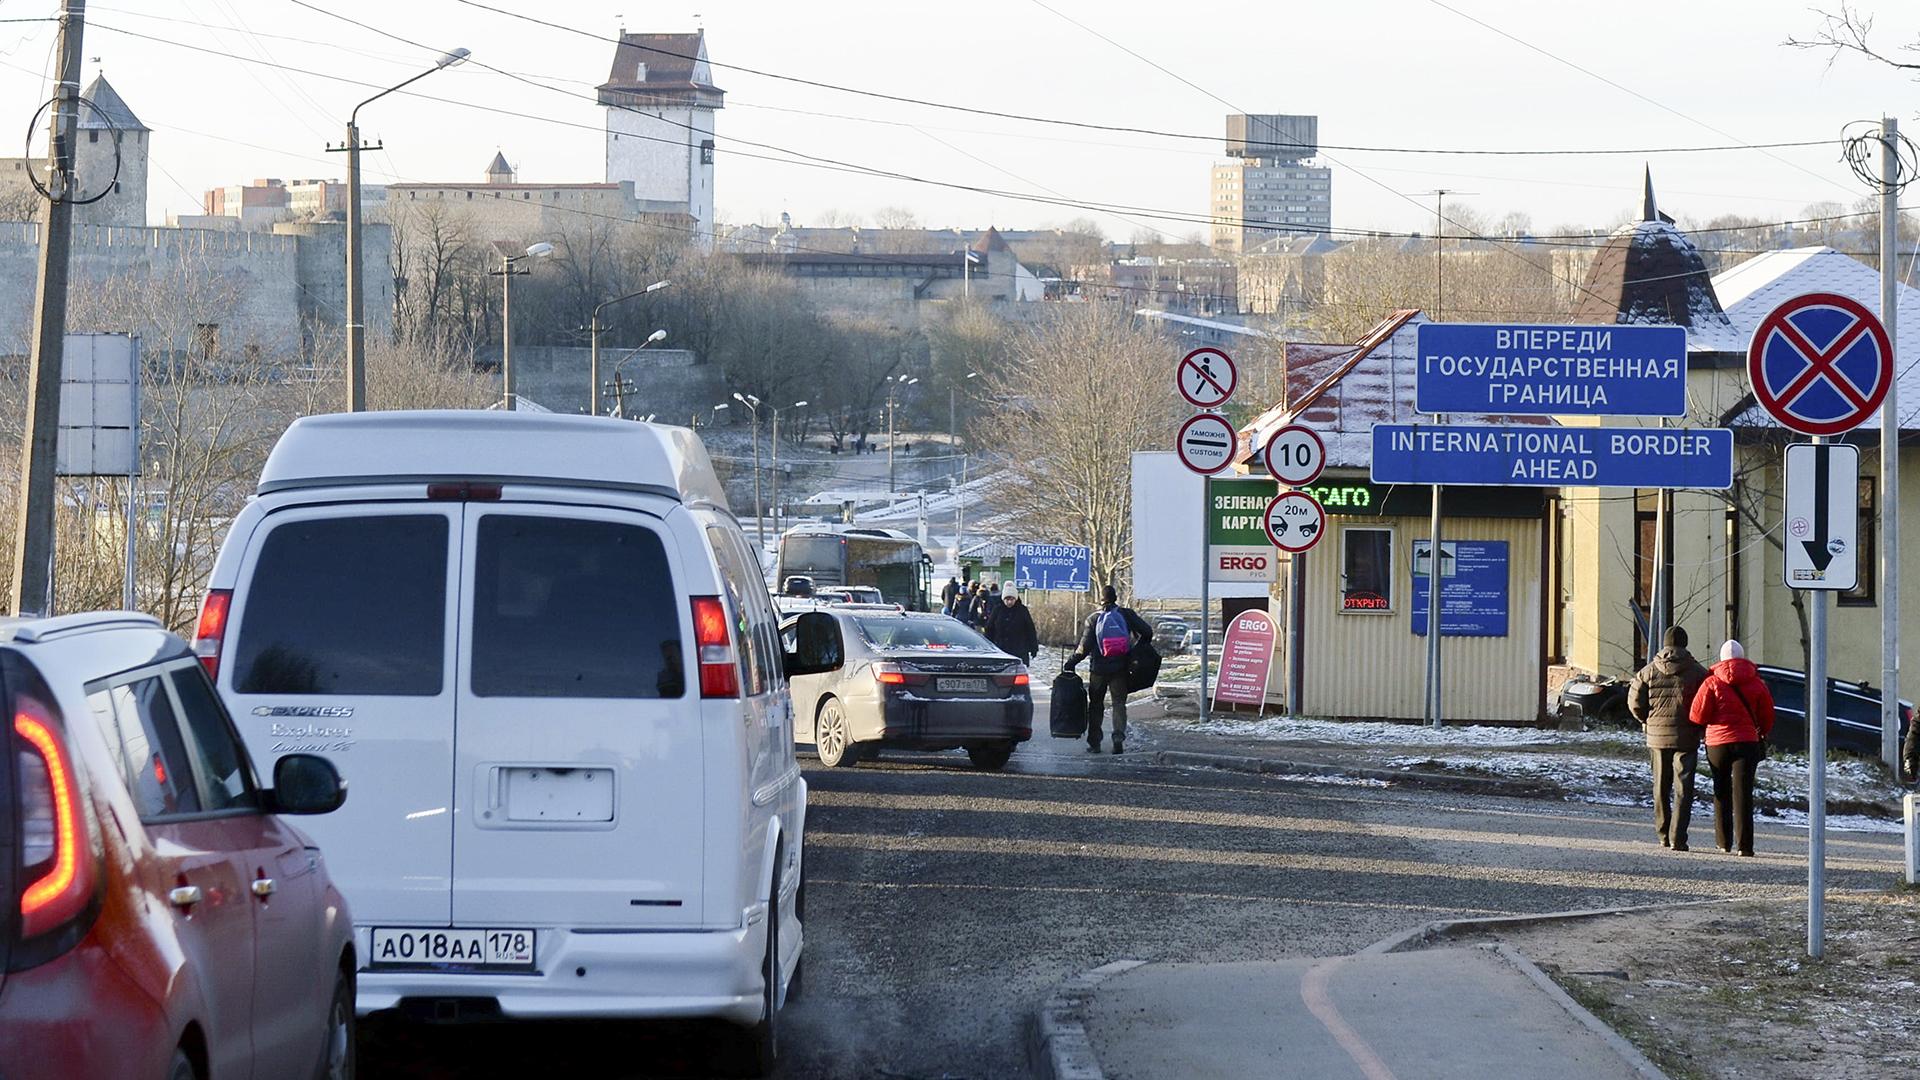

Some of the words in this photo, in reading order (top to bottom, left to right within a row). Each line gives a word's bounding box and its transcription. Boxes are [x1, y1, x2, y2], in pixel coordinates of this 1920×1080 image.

[1496, 329, 1612, 354] ВПЕРЕДИ
[1425, 355, 1679, 379] ГОСУДАРСТВЕННАЯ
[1488, 383, 1609, 408] ГРАНИЦА
[1190, 429, 1226, 439] ТАМОЖНЯ
[1391, 431, 1593, 454] INTERNATIONAL
[1610, 435, 1712, 456] BORDER
[1189, 448, 1223, 458] CUSTOMS
[1280, 443, 1311, 467] 10
[1511, 459, 1598, 480] AHEAD
[1222, 515, 1265, 530] КАРТА
[1019, 545, 1087, 561] ИВАНГОРОД
[1031, 558, 1074, 566] IVANGOROD
[1220, 556, 1267, 570] ERGO
[1344, 598, 1388, 609] ОТКРЫТО
[1239, 620, 1268, 631] ERGO
[271, 706, 354, 717] EXPRESS
[271, 723, 353, 741] Explorer
[382, 933, 482, 959] А018АА
[489, 933, 526, 953] 178
